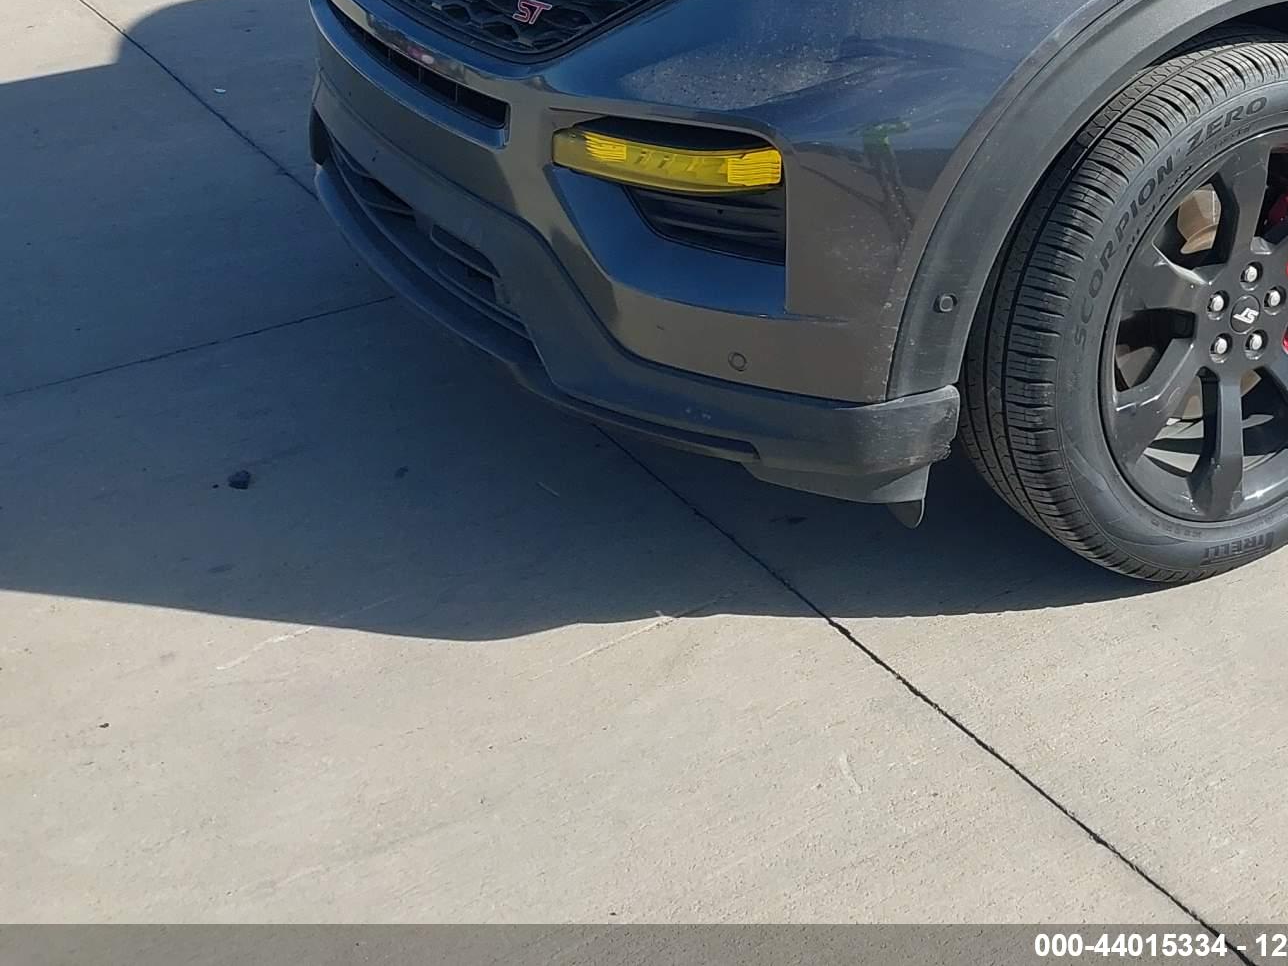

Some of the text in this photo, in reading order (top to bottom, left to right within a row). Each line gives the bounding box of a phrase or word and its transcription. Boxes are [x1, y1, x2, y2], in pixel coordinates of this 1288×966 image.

[1073, 155, 1174, 348] SCORPION
[1186, 96, 1268, 156] ZERO
[1200, 531, 1275, 565] PIRELLI
